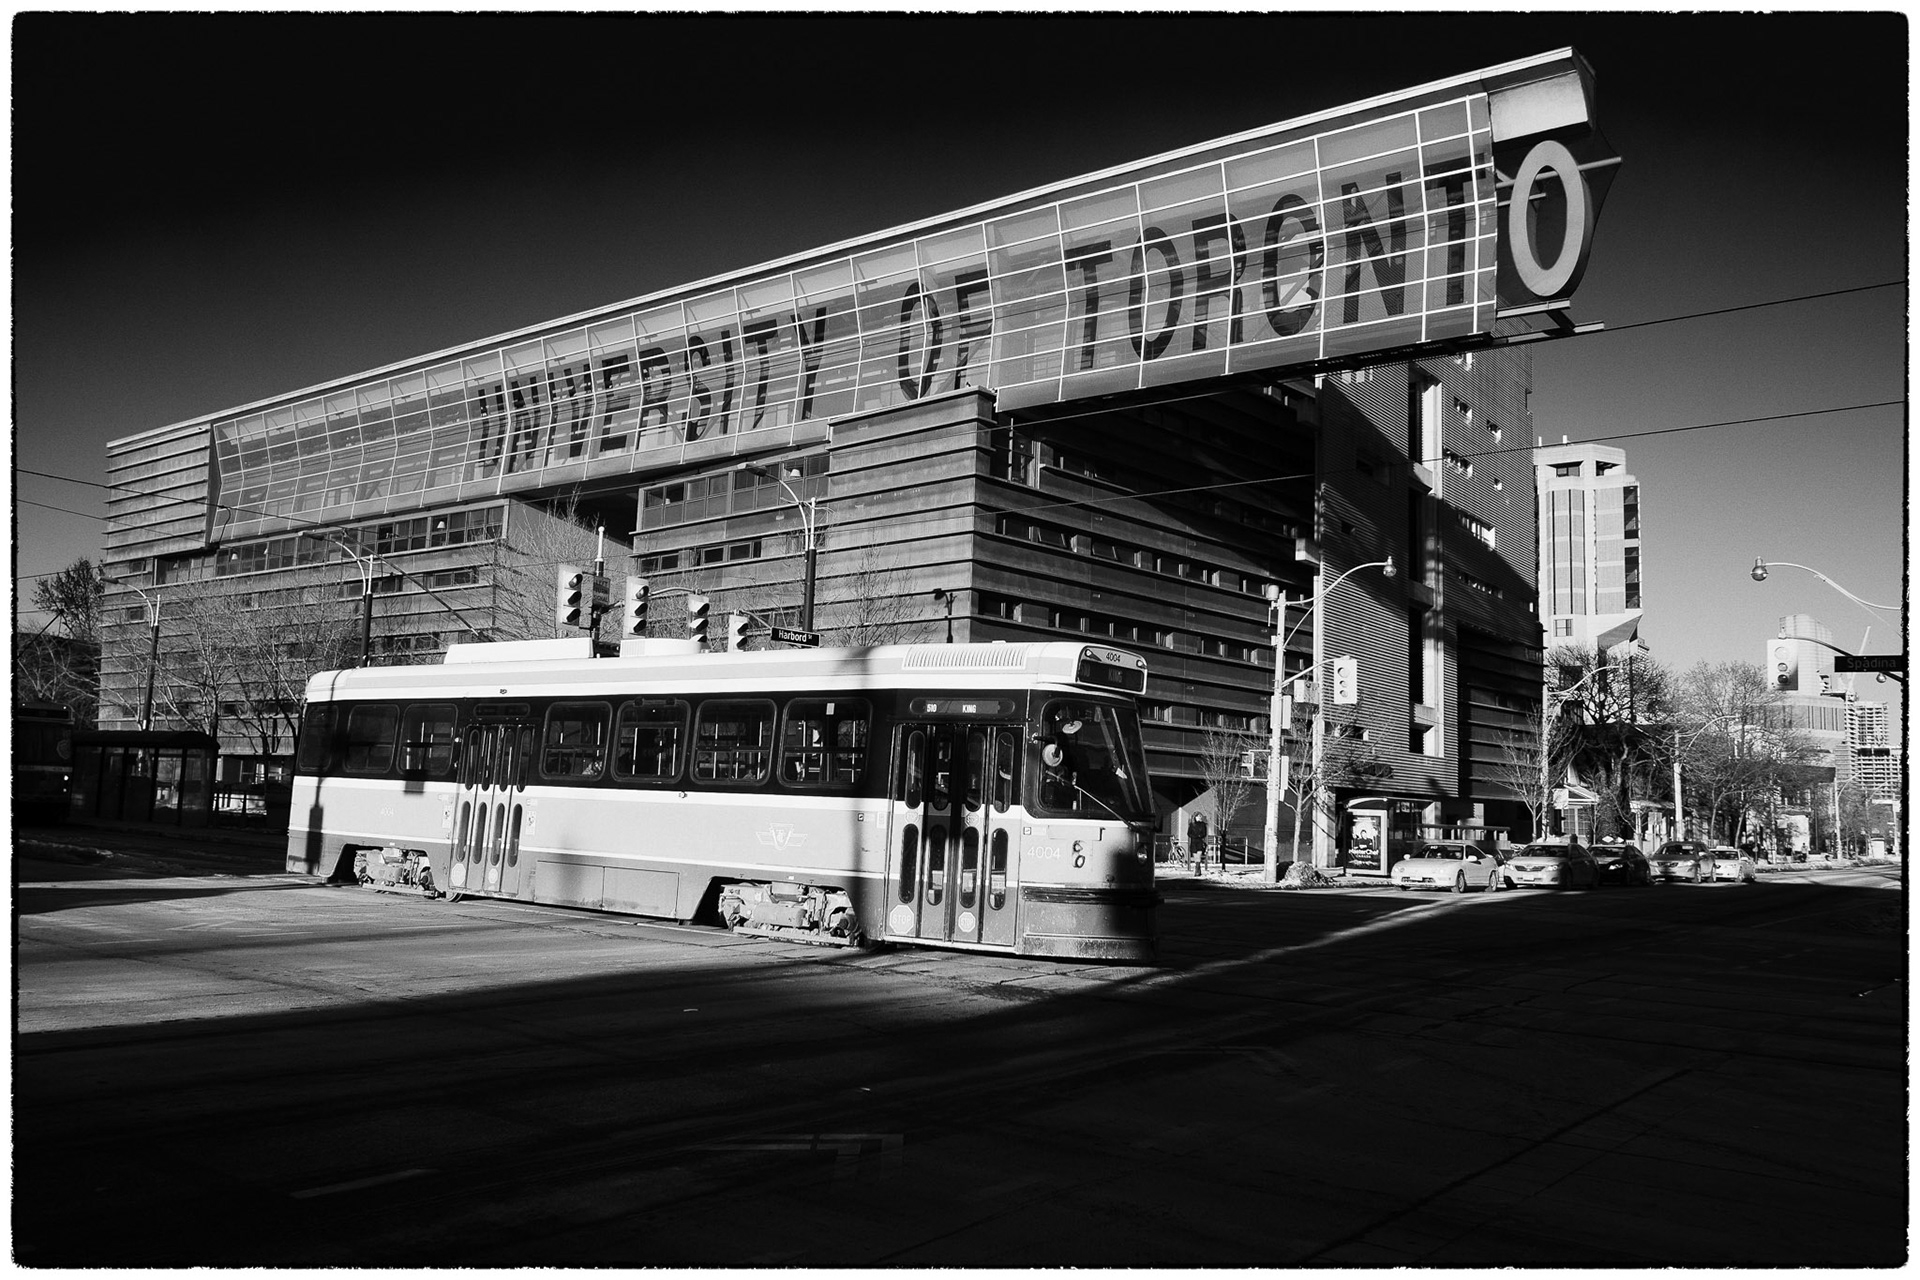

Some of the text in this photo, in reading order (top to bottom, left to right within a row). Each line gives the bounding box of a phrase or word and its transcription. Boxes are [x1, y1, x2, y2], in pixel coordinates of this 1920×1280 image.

[477, 140, 1591, 478] UNIVERSITY OF TORONTO
[778, 630, 807, 642] Harbord
[1106, 652, 1121, 662] 4004
[1847, 658, 1897, 670] Spadina
[926, 703, 977, 713] 510 KING
[1027, 846, 1061, 859] 4004
[893, 914, 911, 924] STOP
